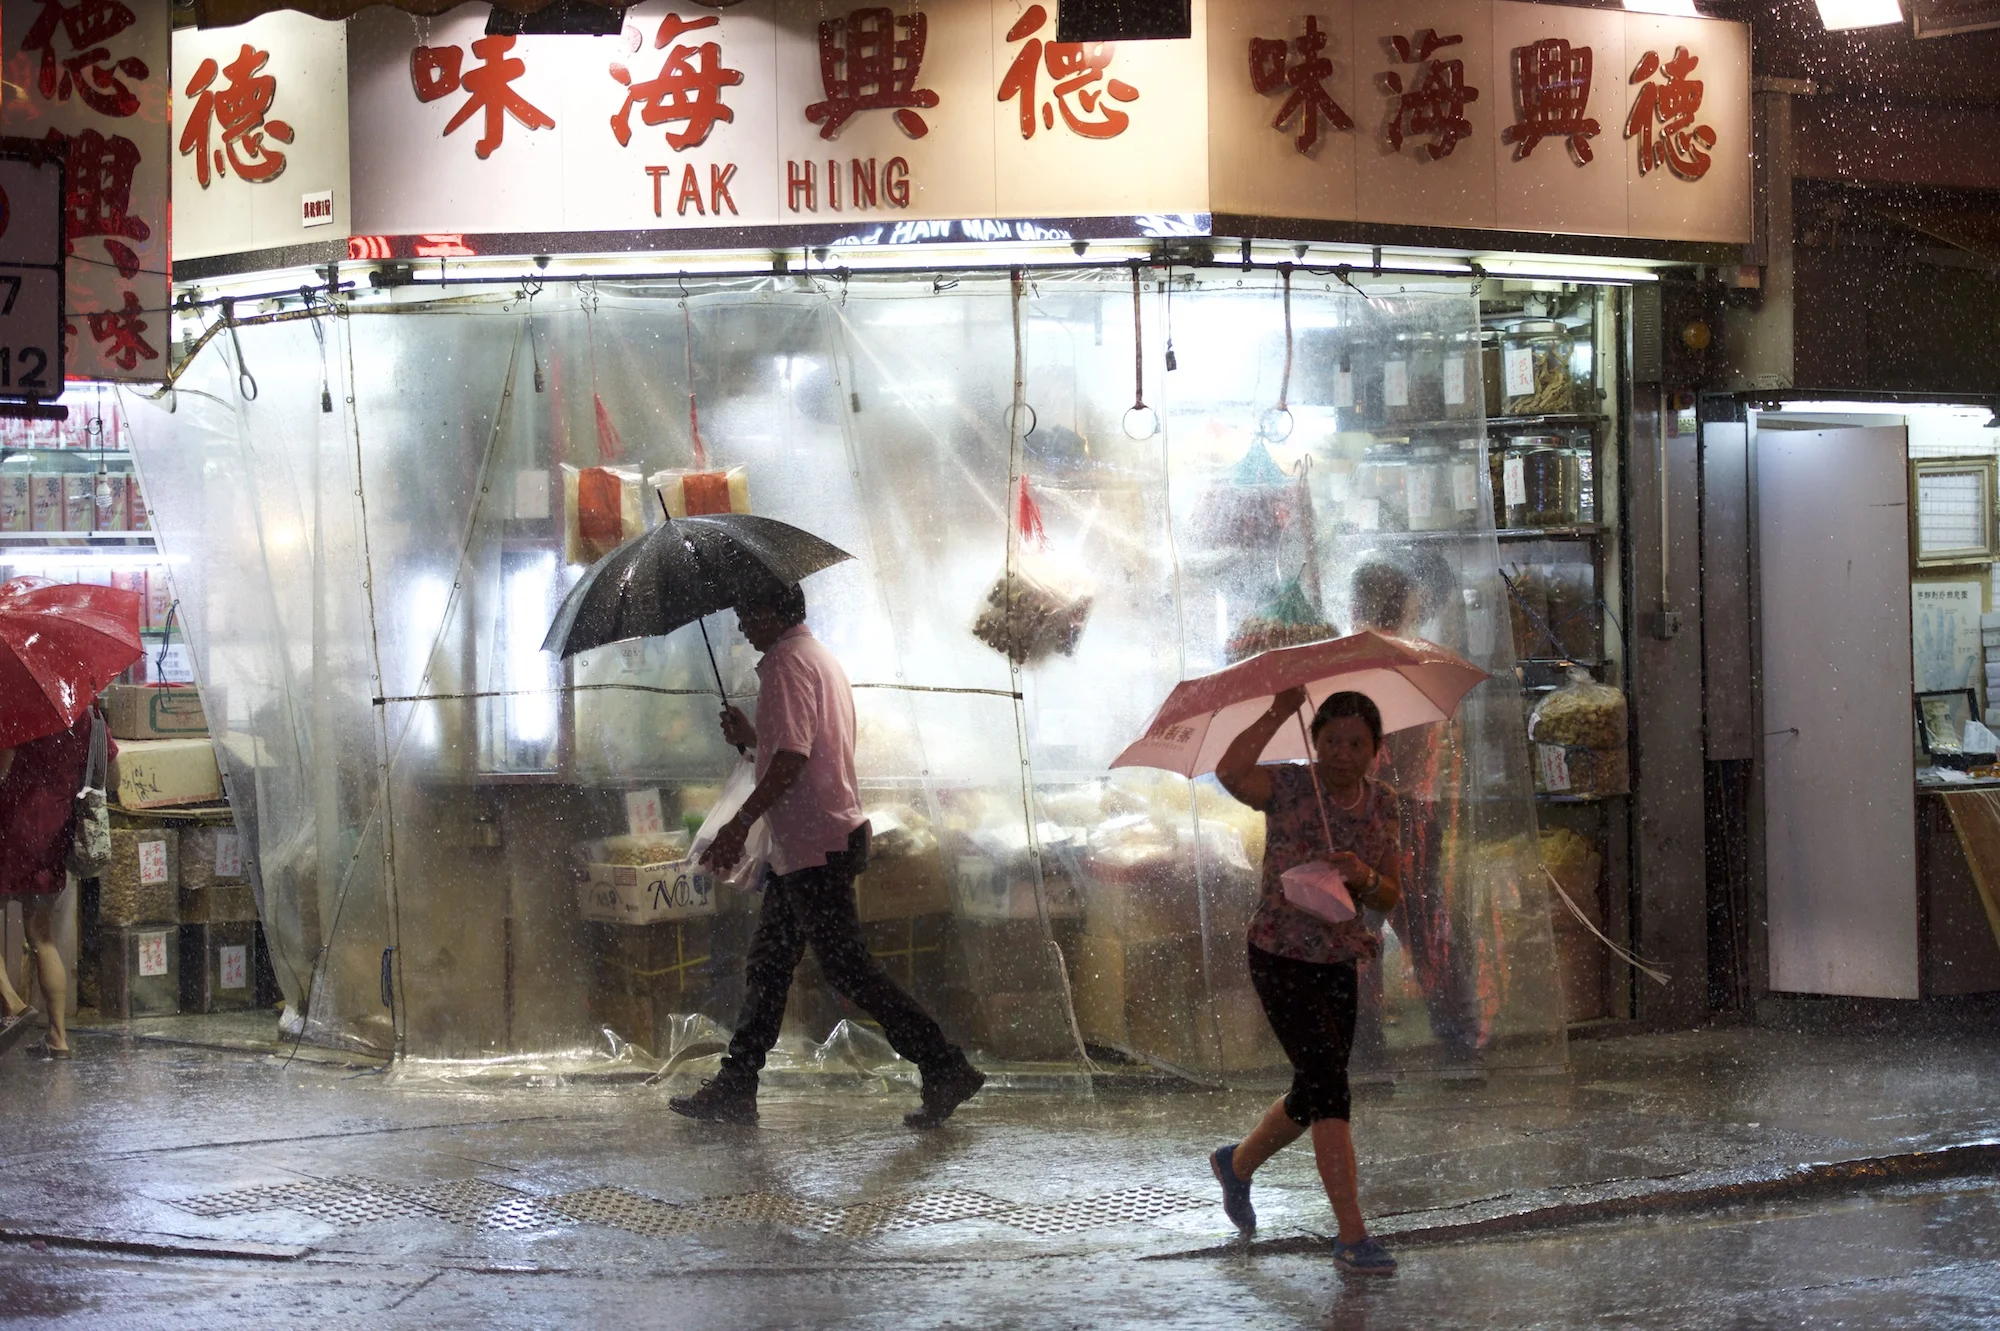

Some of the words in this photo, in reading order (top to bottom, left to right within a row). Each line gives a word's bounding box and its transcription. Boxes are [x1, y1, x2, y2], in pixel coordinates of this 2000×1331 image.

[180, 44, 294, 189] 德
[646, 164, 738, 216] TAK
[788, 157, 911, 210] HING
